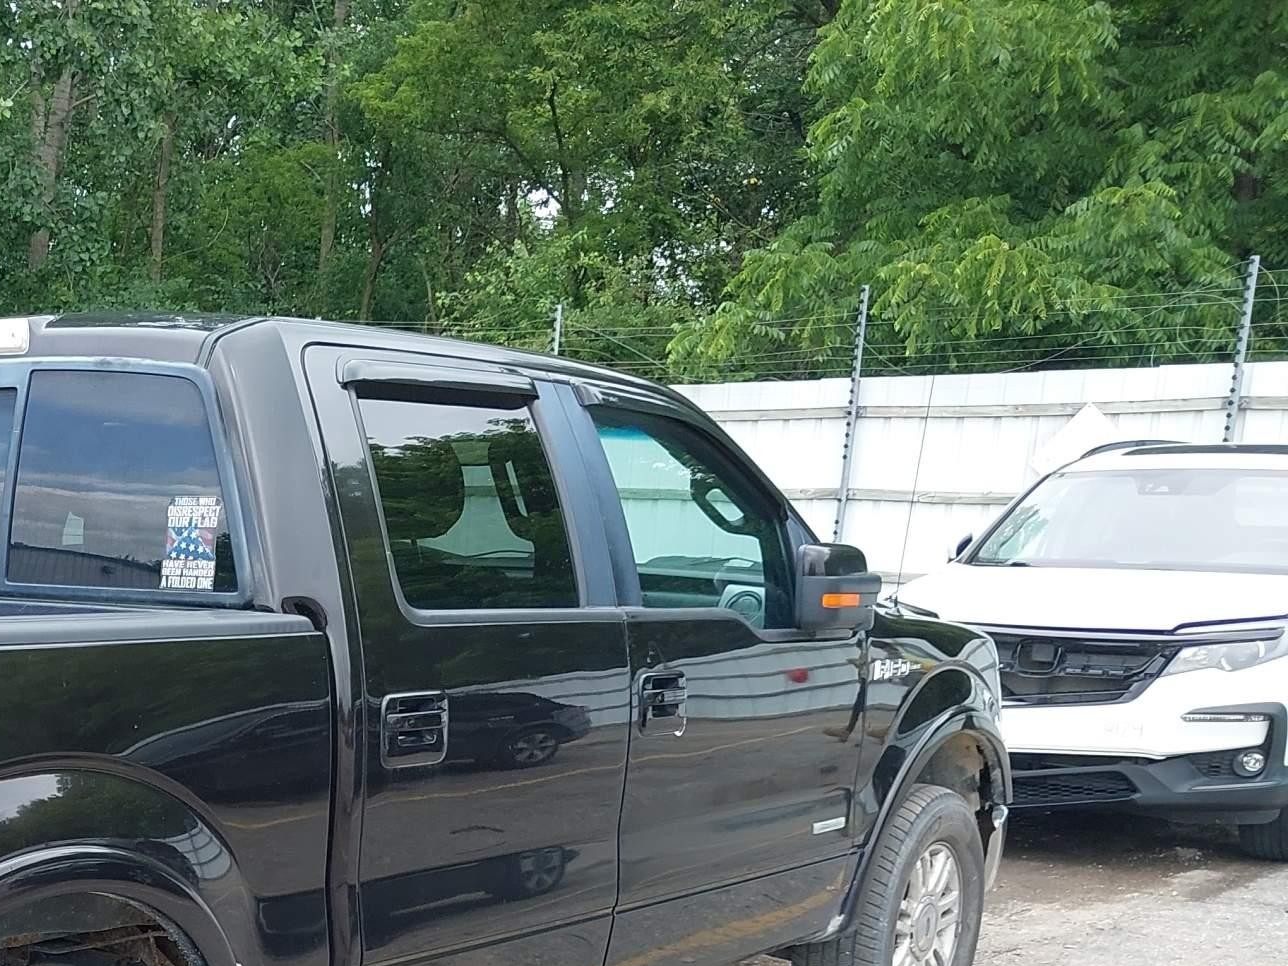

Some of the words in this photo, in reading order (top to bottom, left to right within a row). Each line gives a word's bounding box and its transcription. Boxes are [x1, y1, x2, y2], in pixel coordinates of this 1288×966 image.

[174, 497, 199, 506] THOSE
[199, 497, 217, 506] WHO
[167, 506, 221, 517] DISRESPECT
[168, 517, 190, 528] OUR
[192, 517, 218, 528] FLAG
[162, 560, 185, 568] HAVE
[186, 560, 215, 569] NEVER
[161, 568, 181, 576] BEEN
[160, 577, 167, 589] A
[167, 577, 196, 589] FOLDED
[197, 577, 214, 590] ONE
